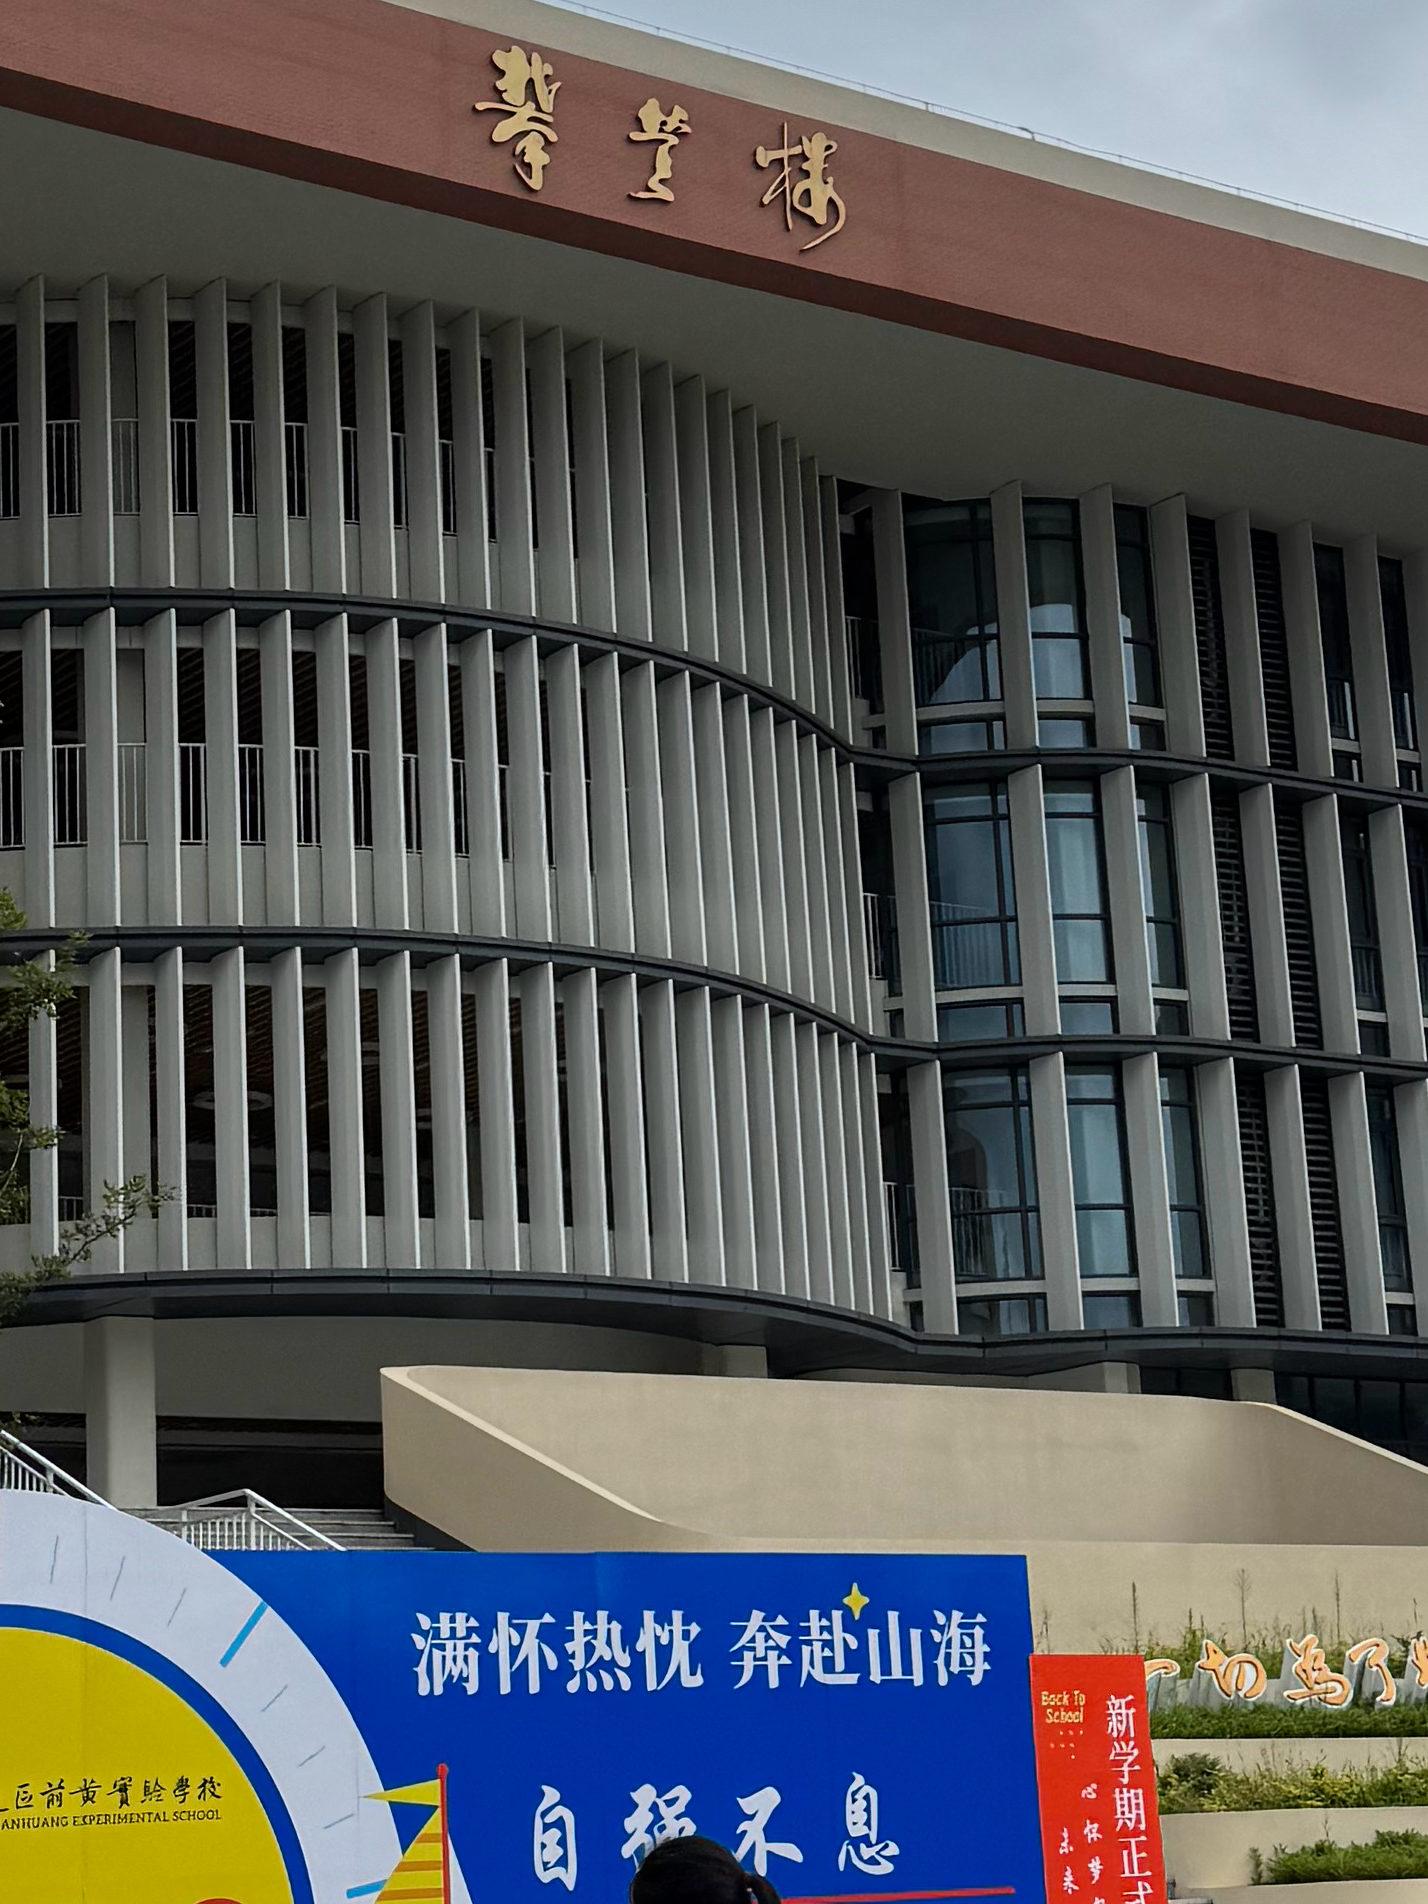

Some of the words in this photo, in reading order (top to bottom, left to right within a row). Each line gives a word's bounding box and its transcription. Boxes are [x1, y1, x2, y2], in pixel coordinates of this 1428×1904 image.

[410, 1610, 704, 1696] 满怀热忱
[730, 1609, 991, 1690] 奔赴山海
[1041, 1690, 1070, 1706] Back
[1045, 1707, 1084, 1724] School
[72, 1811, 170, 1827] EXPERIMENTAL
[172, 1808, 222, 1822] SCHOOL
